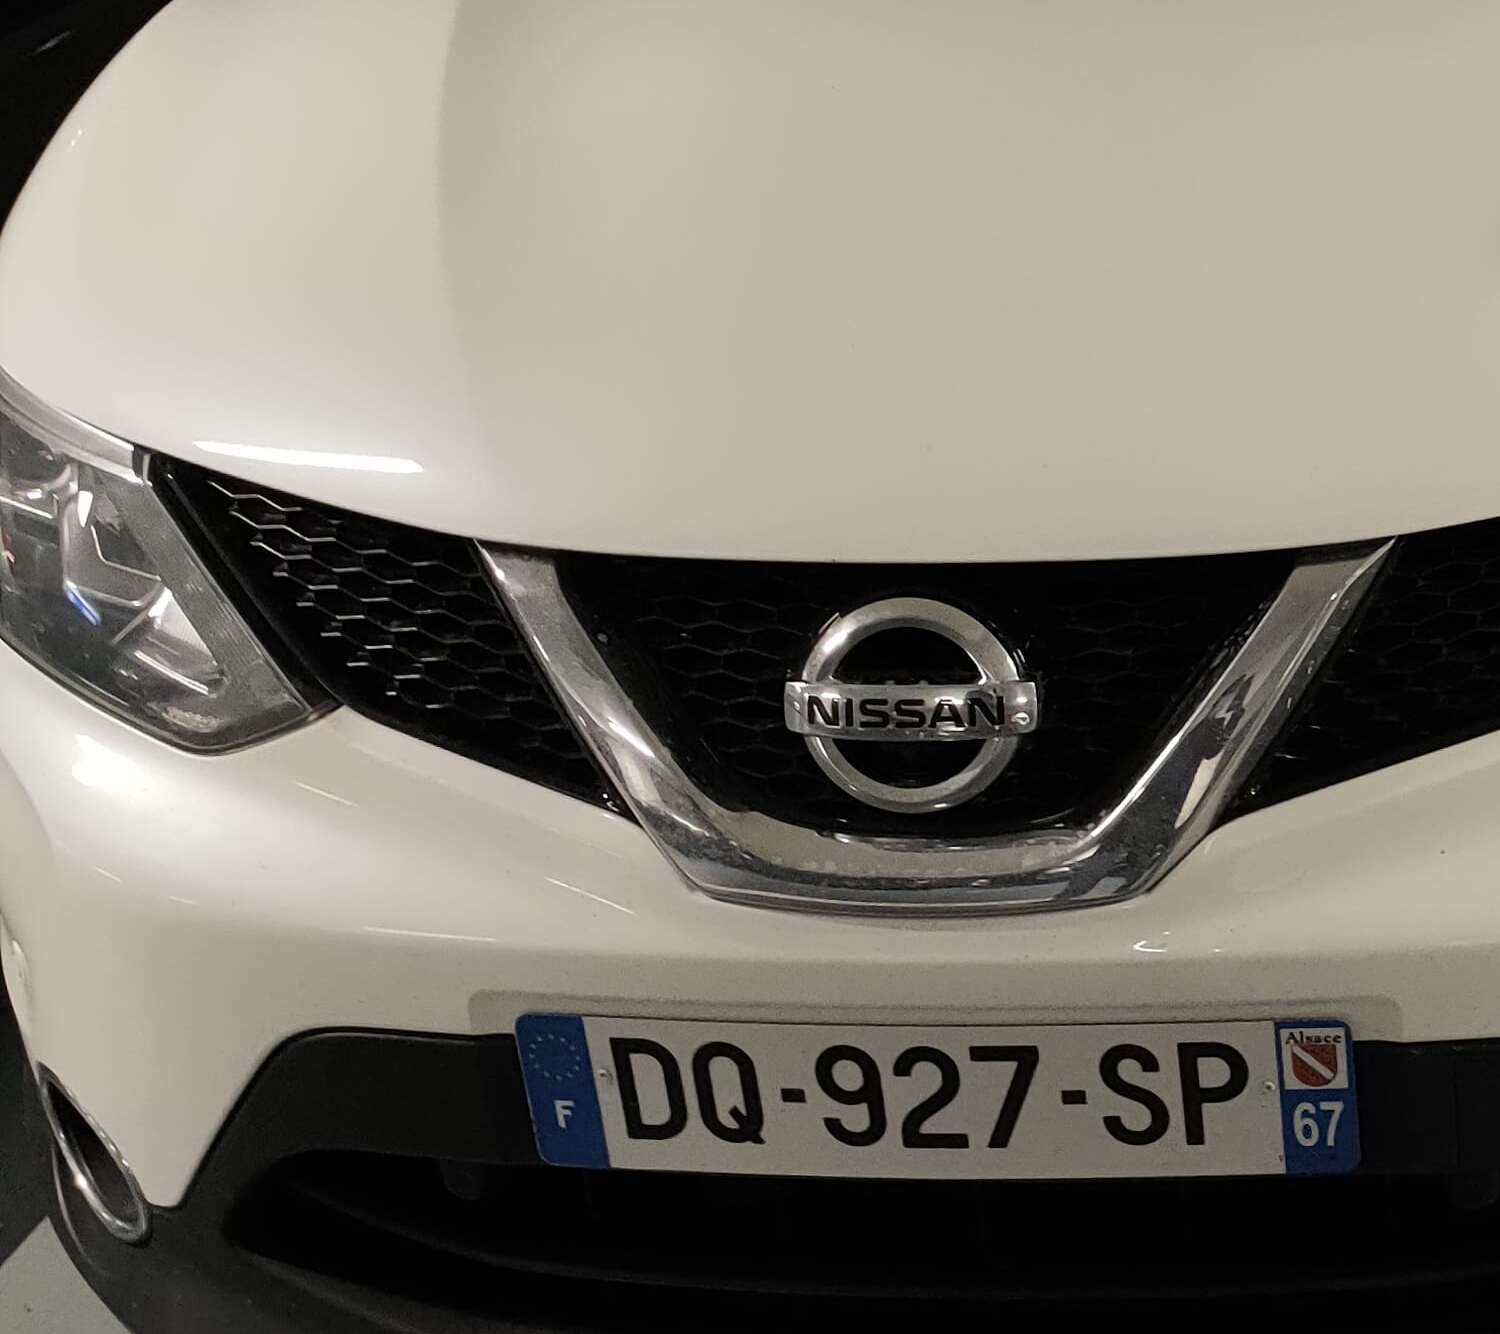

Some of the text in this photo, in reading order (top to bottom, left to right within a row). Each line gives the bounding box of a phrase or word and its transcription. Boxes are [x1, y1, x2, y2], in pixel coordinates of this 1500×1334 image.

[806, 694, 1005, 728] NISSAN
[1285, 1030, 1342, 1044] Alsace
[607, 1036, 1250, 1150] DQ-927-SP
[554, 1099, 576, 1129] F
[1293, 1100, 1344, 1147] 67
